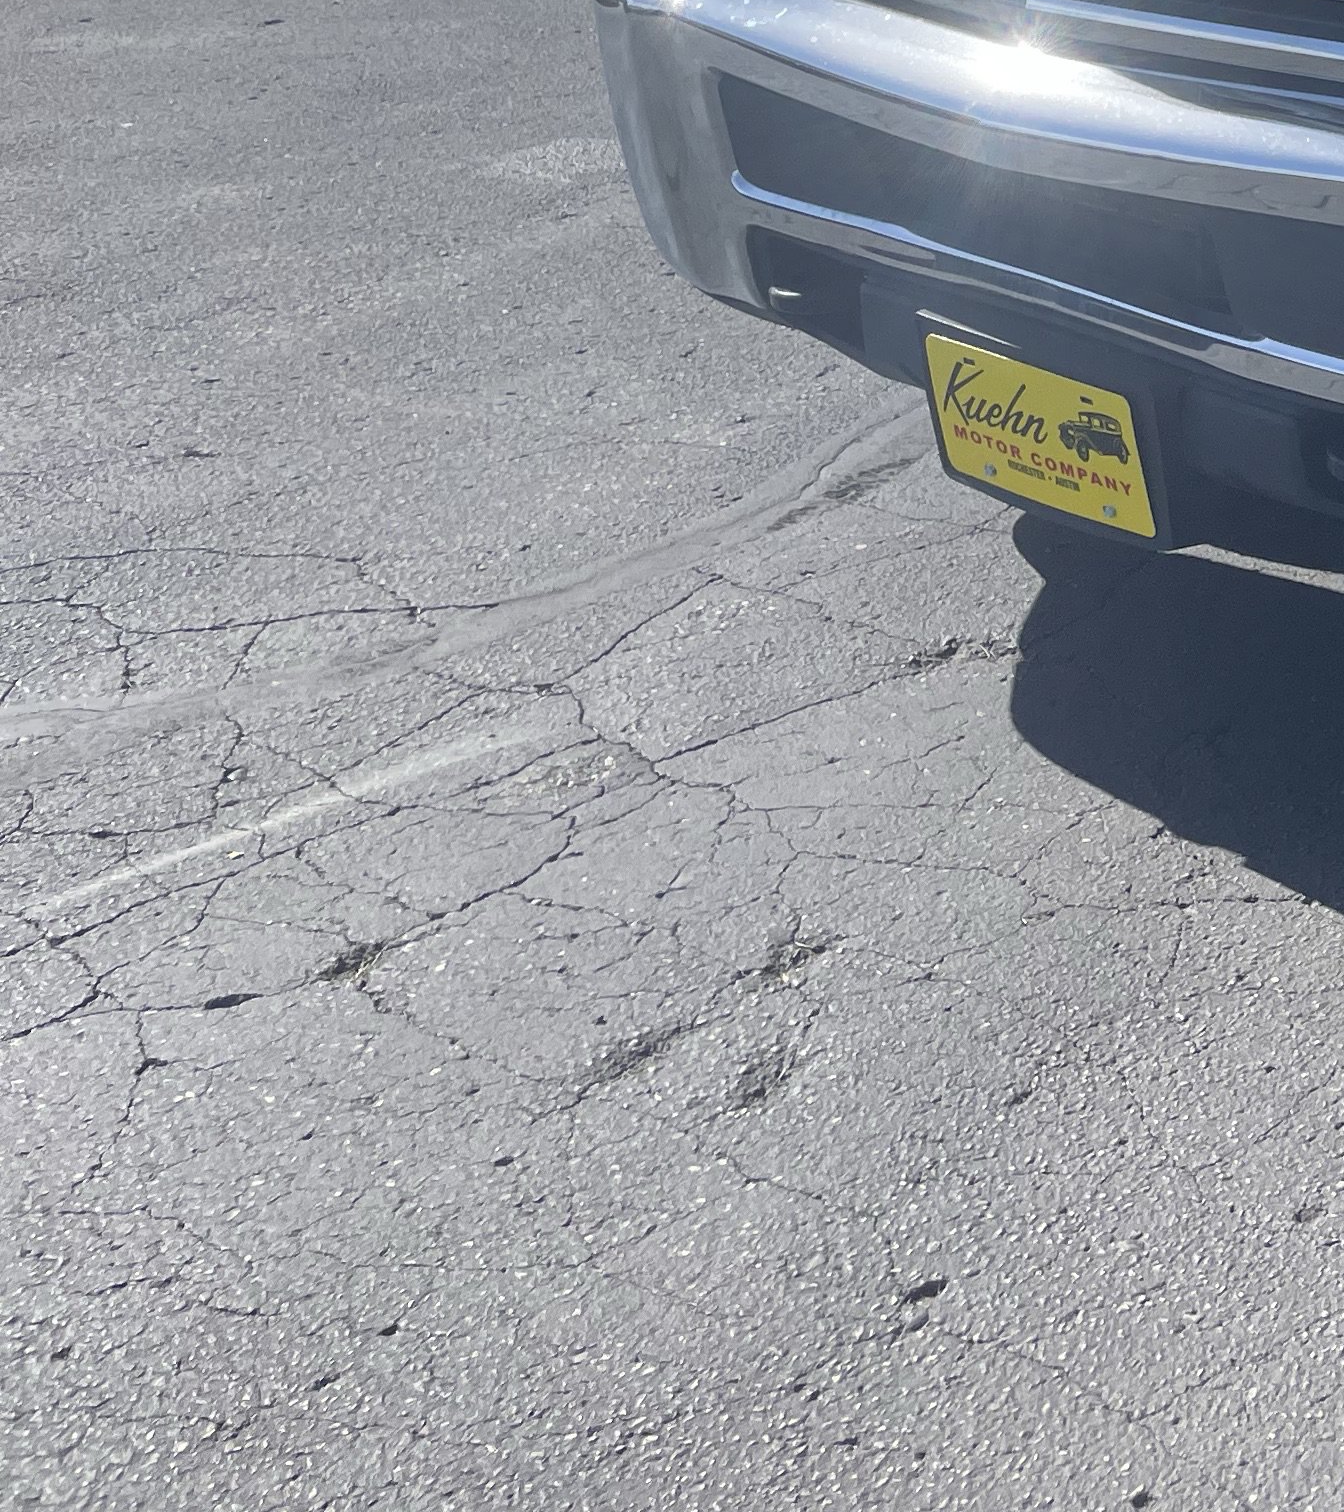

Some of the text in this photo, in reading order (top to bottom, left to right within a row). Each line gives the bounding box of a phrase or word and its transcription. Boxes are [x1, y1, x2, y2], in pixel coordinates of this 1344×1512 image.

[943, 361, 1048, 445] Kuehn
[953, 424, 1132, 497] MOTOR COMPANY
